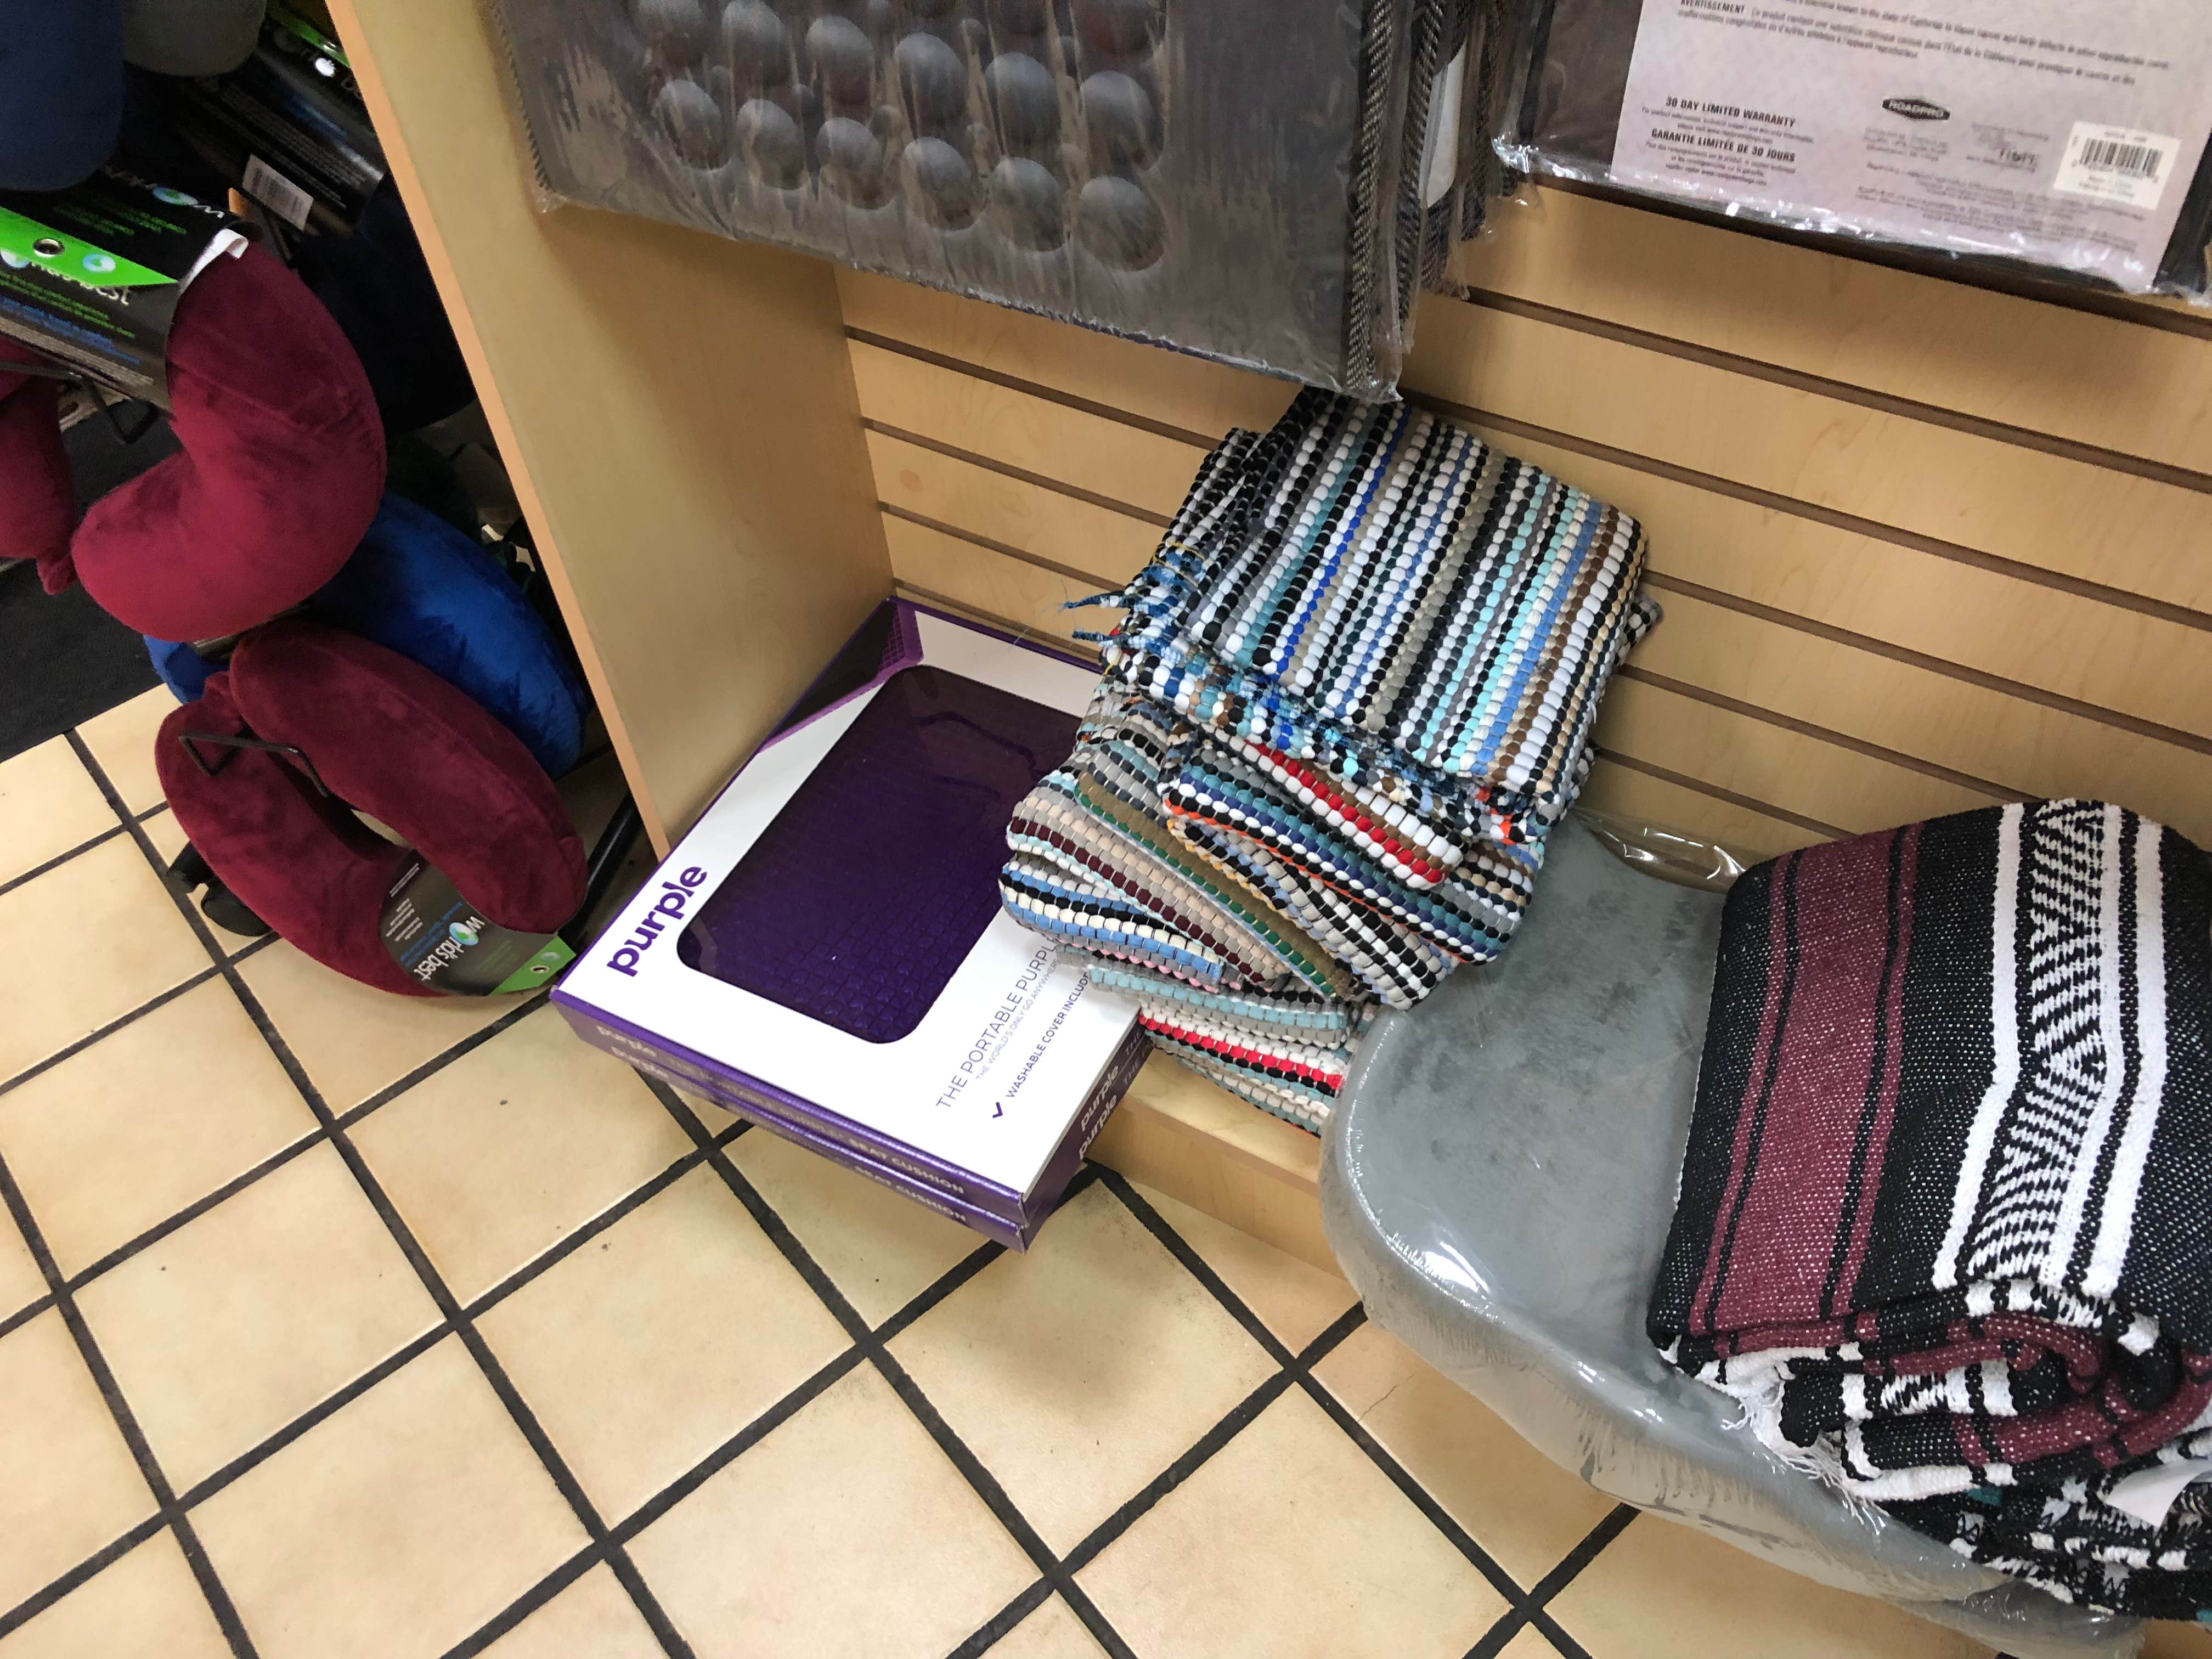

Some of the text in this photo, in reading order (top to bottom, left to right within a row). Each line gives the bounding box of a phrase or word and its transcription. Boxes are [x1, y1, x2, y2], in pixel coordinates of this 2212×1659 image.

[1651, 127, 1695, 144] GARANTIE
[1737, 143, 1748, 154] DE
[1752, 145, 1764, 157] 30
[1767, 148, 1796, 163] JOURS
[1666, 96, 1796, 127] 30 DAY LIMITED WARRANTY
[435, 916, 486, 961] world's
[606, 866, 707, 977] purple
[413, 953, 449, 982] best
[936, 1075, 968, 1108] THE
[960, 992, 1023, 1074] PORTABLE
[976, 1065, 990, 1080] THE
[988, 1030, 1013, 1064] WORLD'S
[1009, 1009, 1025, 1031] ONLY
[1023, 998, 1034, 1011] GO
[1006, 972, 1090, 1098] WASHABLE COVER INCLUDE
[1079, 1057, 1141, 1161] purple THE
[1081, 1030, 1142, 1132] purple THE
[849, 1138, 887, 1160] SEAT
[891, 1156, 964, 1194] CUSHION
[895, 1184, 966, 1222] CUSHION
